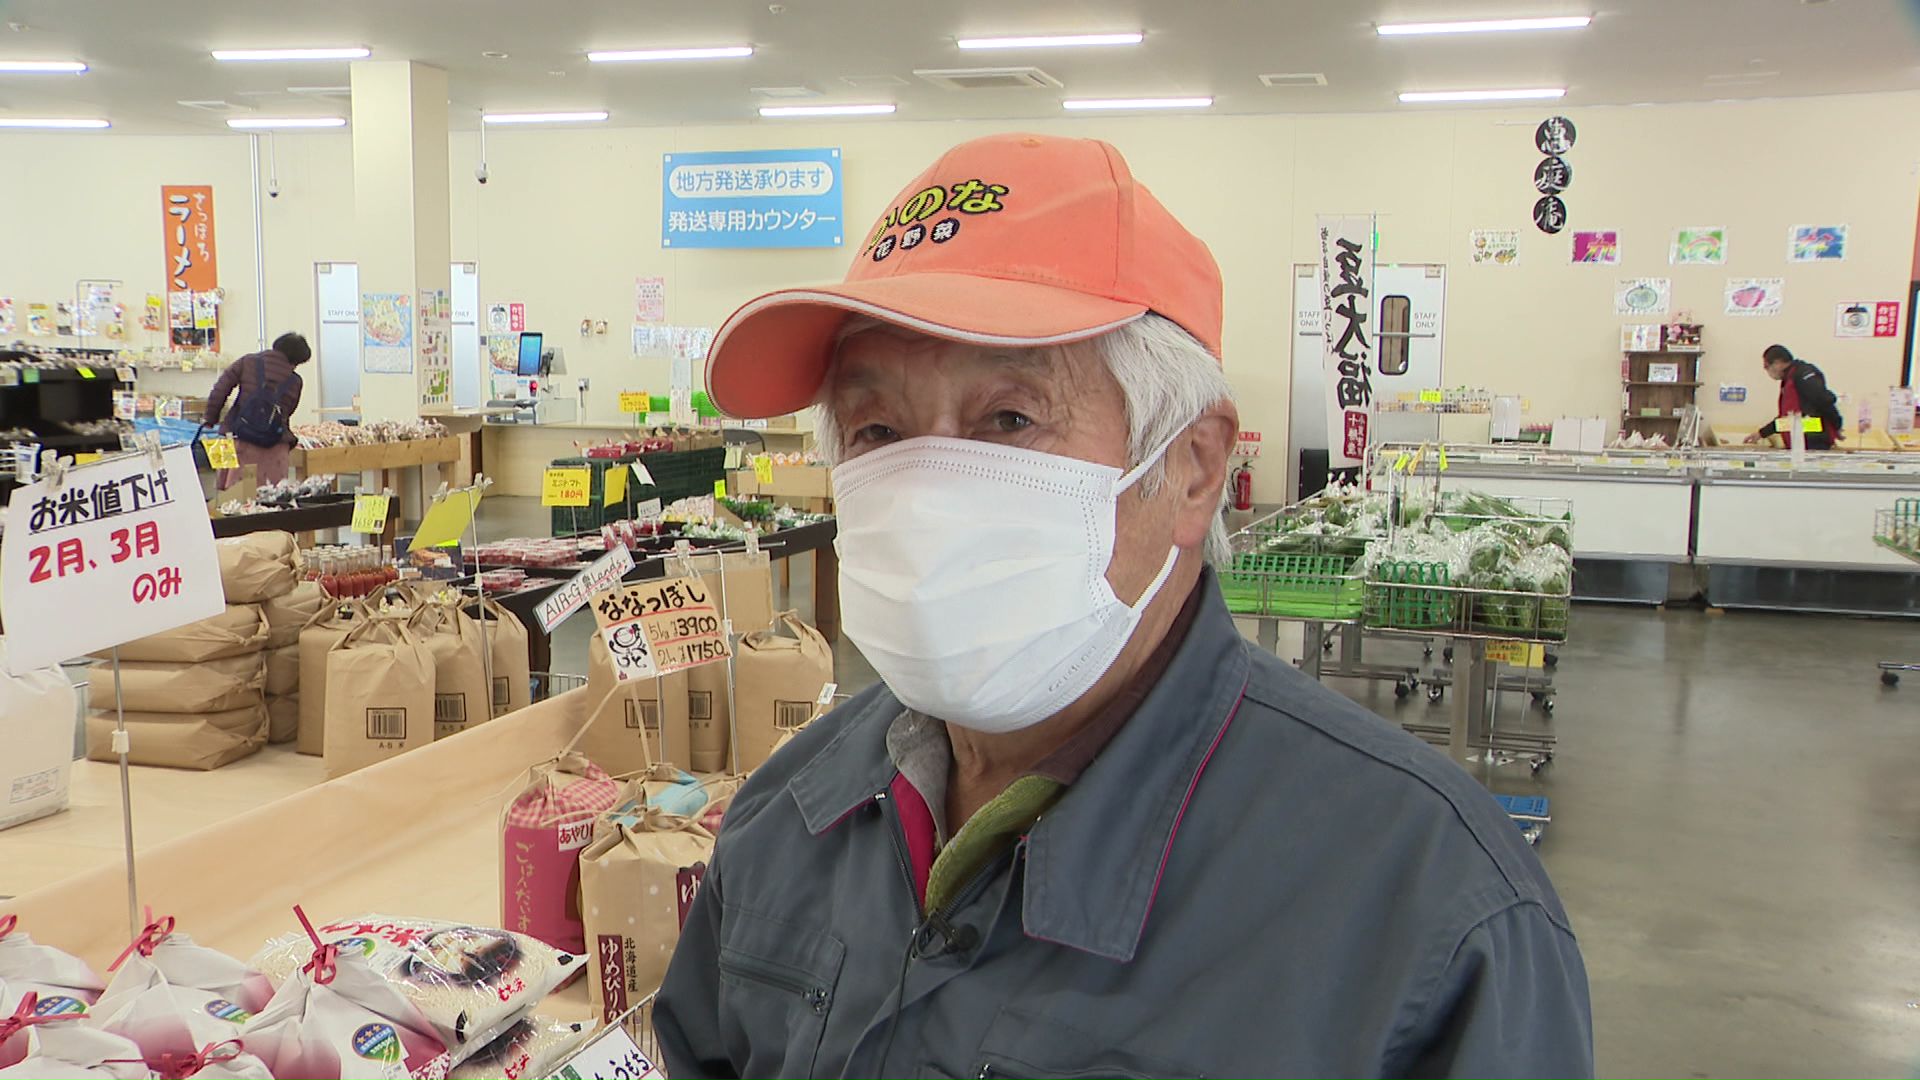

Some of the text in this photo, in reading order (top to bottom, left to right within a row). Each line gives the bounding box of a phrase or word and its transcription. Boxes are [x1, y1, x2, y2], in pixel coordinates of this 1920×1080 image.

[676, 167, 826, 192] 地方発送承ります
[668, 209, 836, 233] 発送専用カウンター
[873, 217, 960, 261] 花野菜
[1299, 319, 1319, 327] ONLY
[1414, 312, 1437, 320] STAFF
[1415, 321, 1435, 329] ONLY
[29, 469, 171, 531] お米値下げ
[560, 489, 583, 499] 180円
[28, 520, 161, 583] 2月、3月
[132, 566, 182, 604] のみ
[624, 937, 638, 992] 北海道産
[497, 977, 526, 1001] もち米
